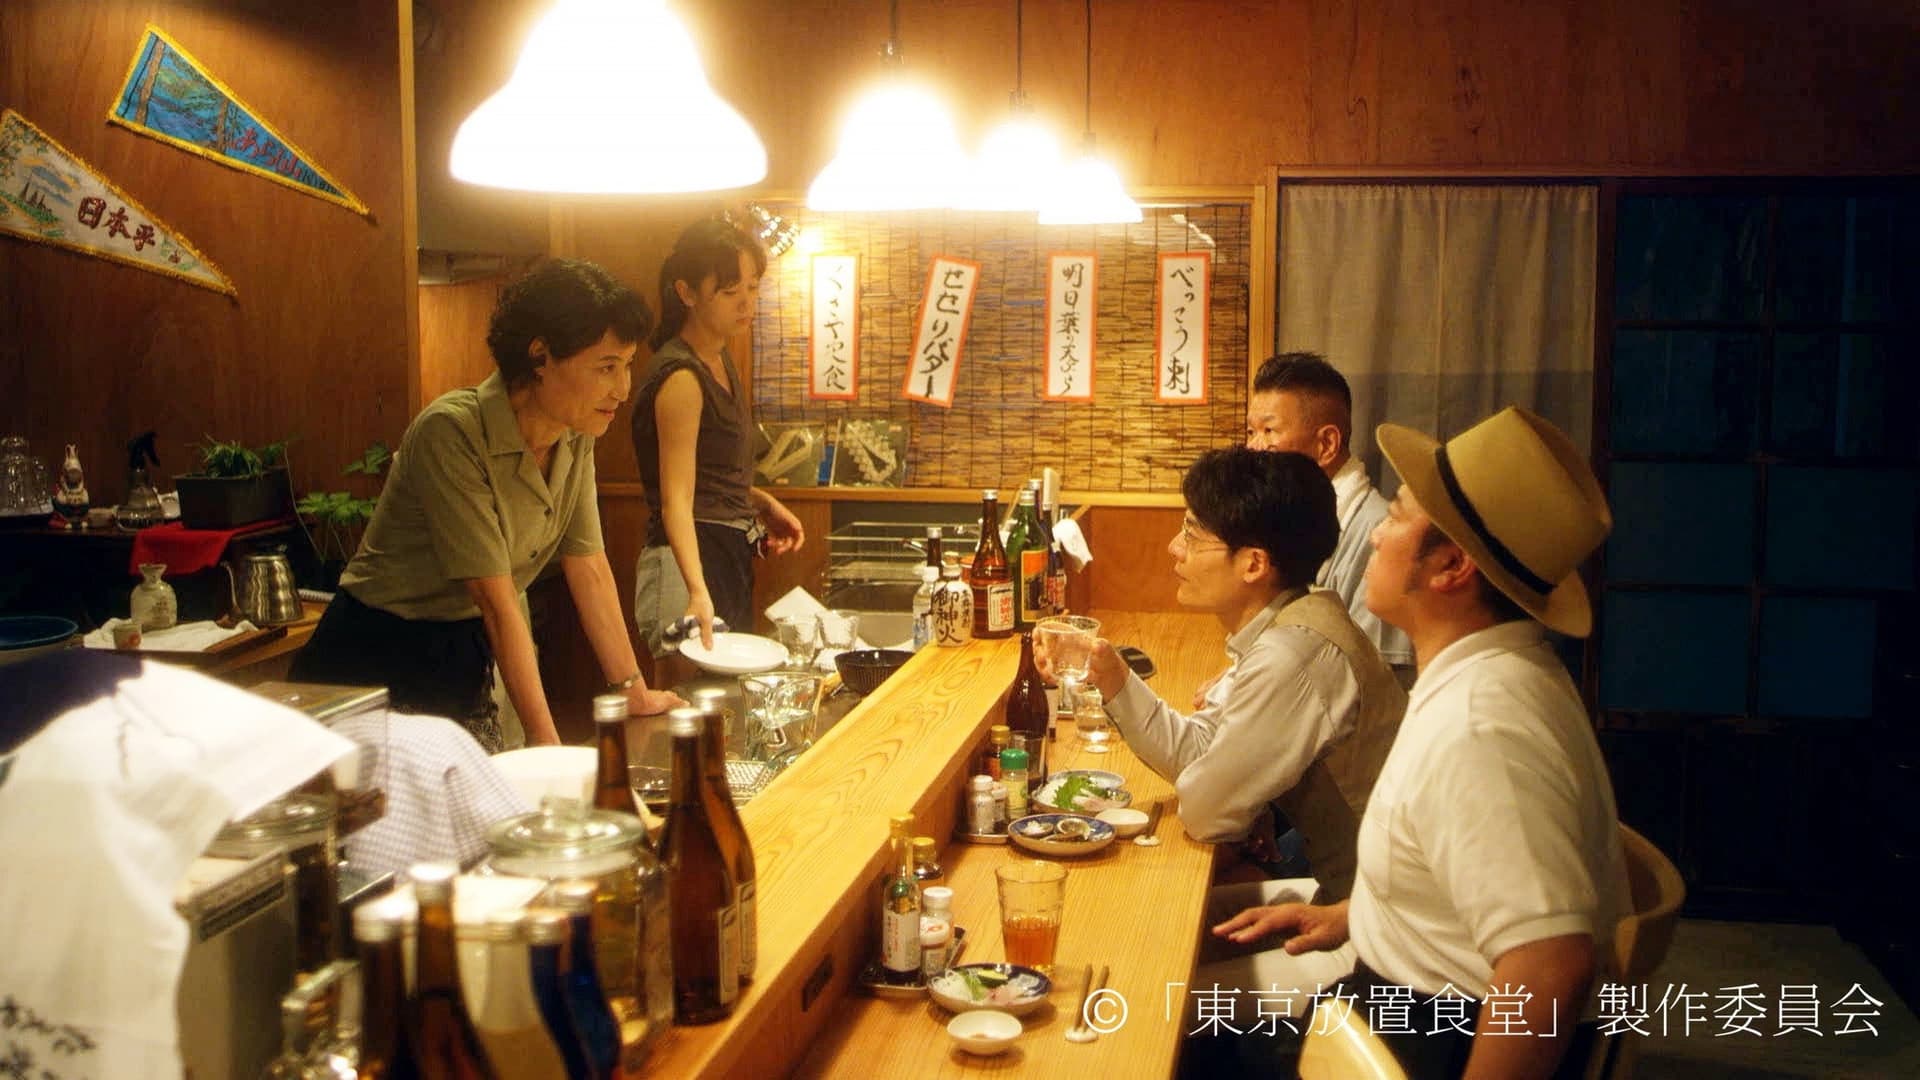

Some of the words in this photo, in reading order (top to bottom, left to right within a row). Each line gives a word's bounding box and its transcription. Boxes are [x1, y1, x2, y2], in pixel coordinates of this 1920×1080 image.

[78, 196, 155, 252] 日本平
[1165, 265, 1196, 395] べっこう刺
[931, 585, 964, 643] 御神火
